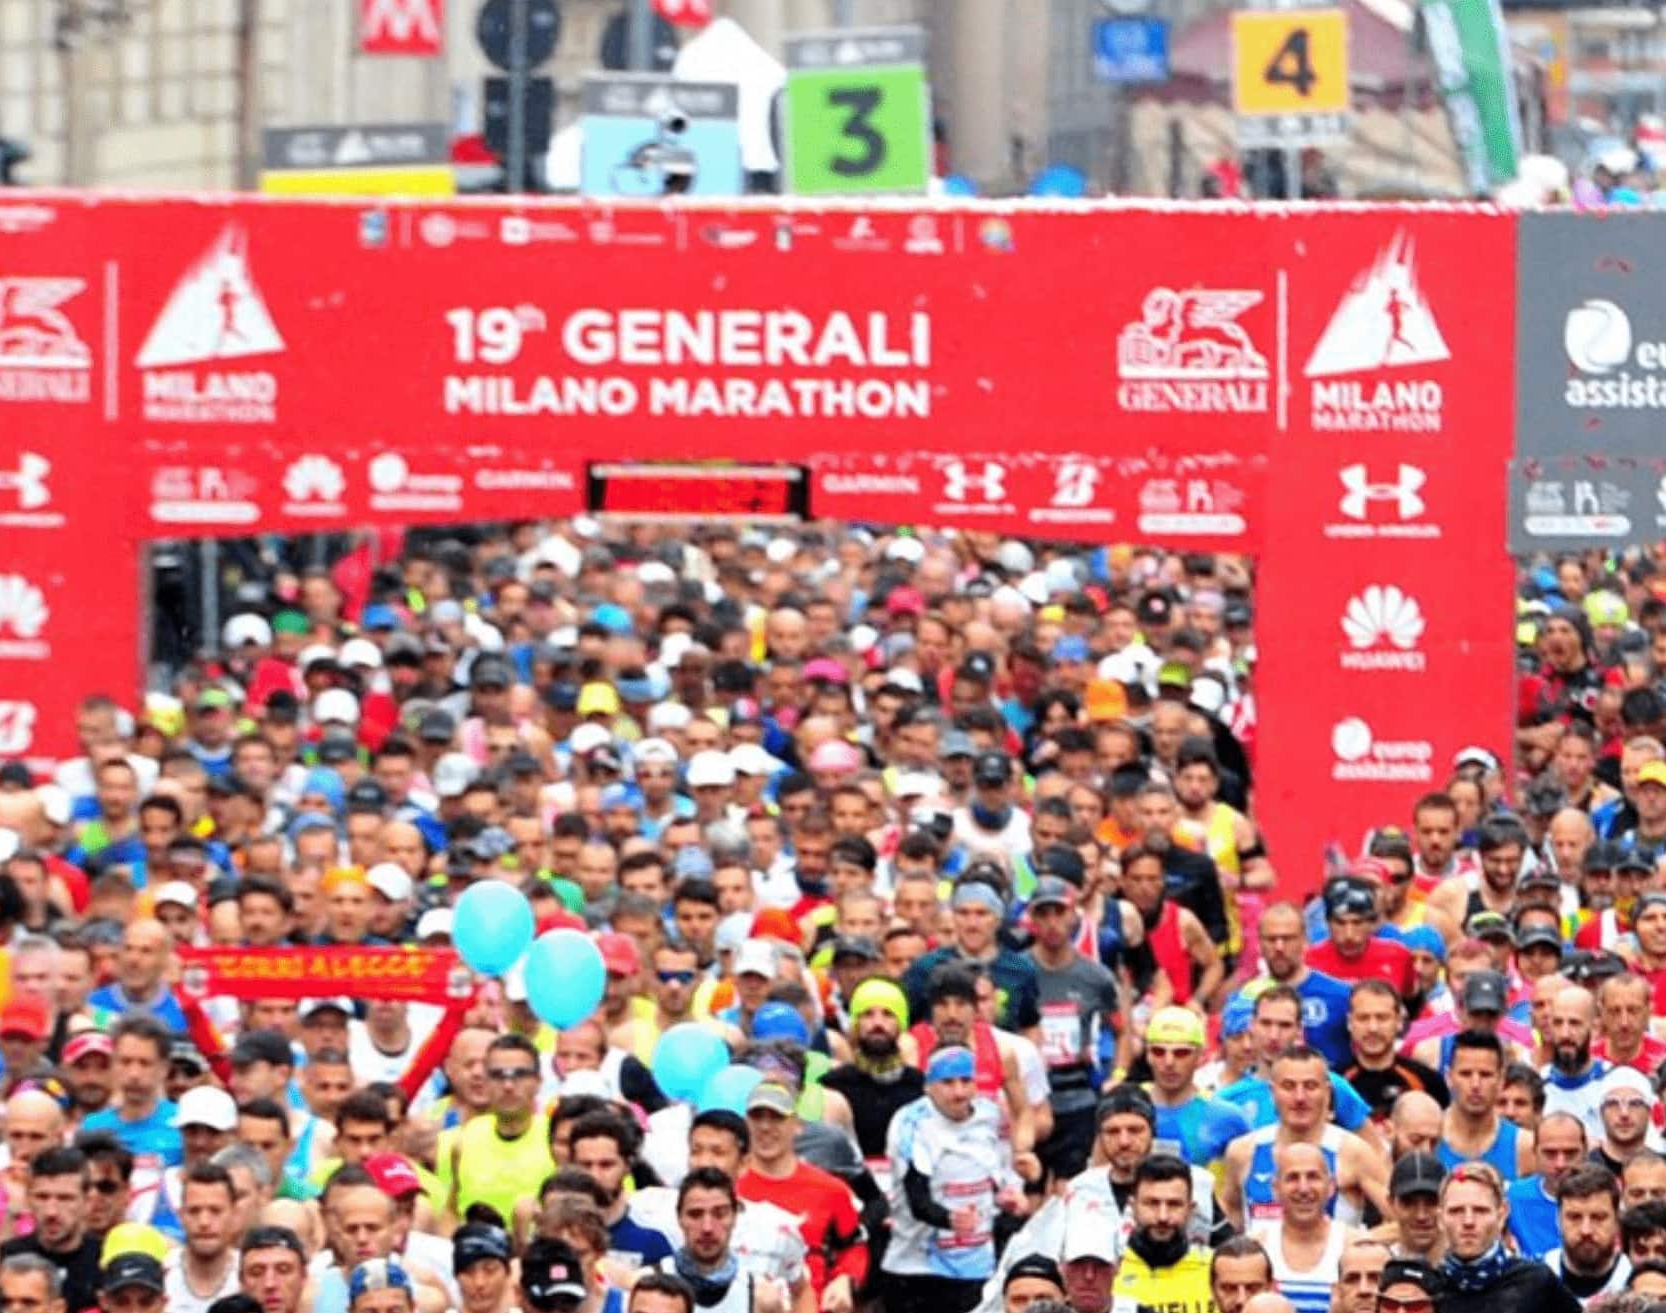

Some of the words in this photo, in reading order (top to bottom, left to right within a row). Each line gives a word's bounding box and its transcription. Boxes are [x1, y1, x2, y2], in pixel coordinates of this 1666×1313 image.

[1264, 28, 1316, 96] 4
[829, 88, 886, 176] 3
[563, 309, 930, 367] GENERALI
[142, 371, 277, 403] MILANO
[444, 376, 637, 416] MILANO
[650, 379, 930, 418] MARATHON
[1118, 381, 1269, 413] GENERALI
[1312, 381, 1443, 411] MILANO
[1312, 412, 1441, 432] MARATHON
